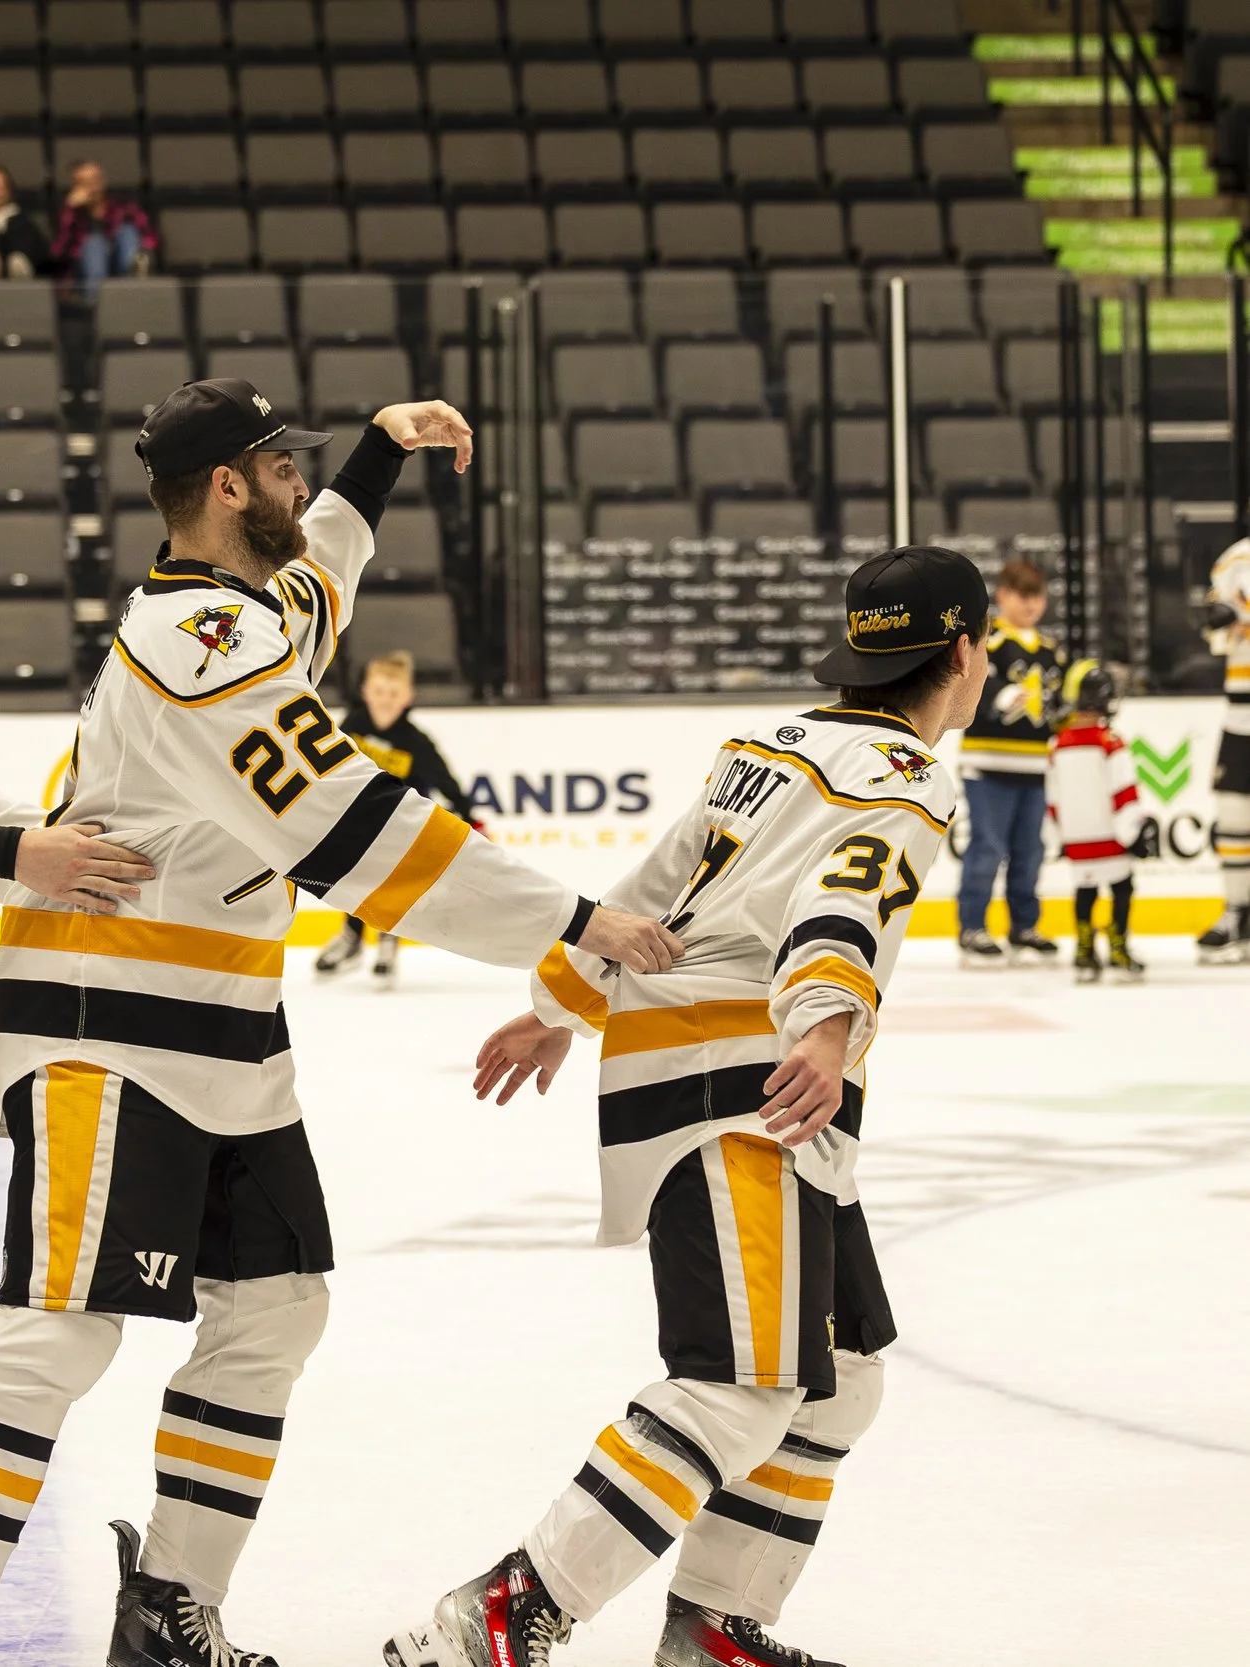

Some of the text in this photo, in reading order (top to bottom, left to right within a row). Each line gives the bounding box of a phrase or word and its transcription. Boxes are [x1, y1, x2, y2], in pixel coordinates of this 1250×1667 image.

[850, 609, 911, 637] Nailers
[864, 603, 905, 617] WHEELING
[229, 681, 359, 819] 22
[462, 773, 651, 816] ANDS
